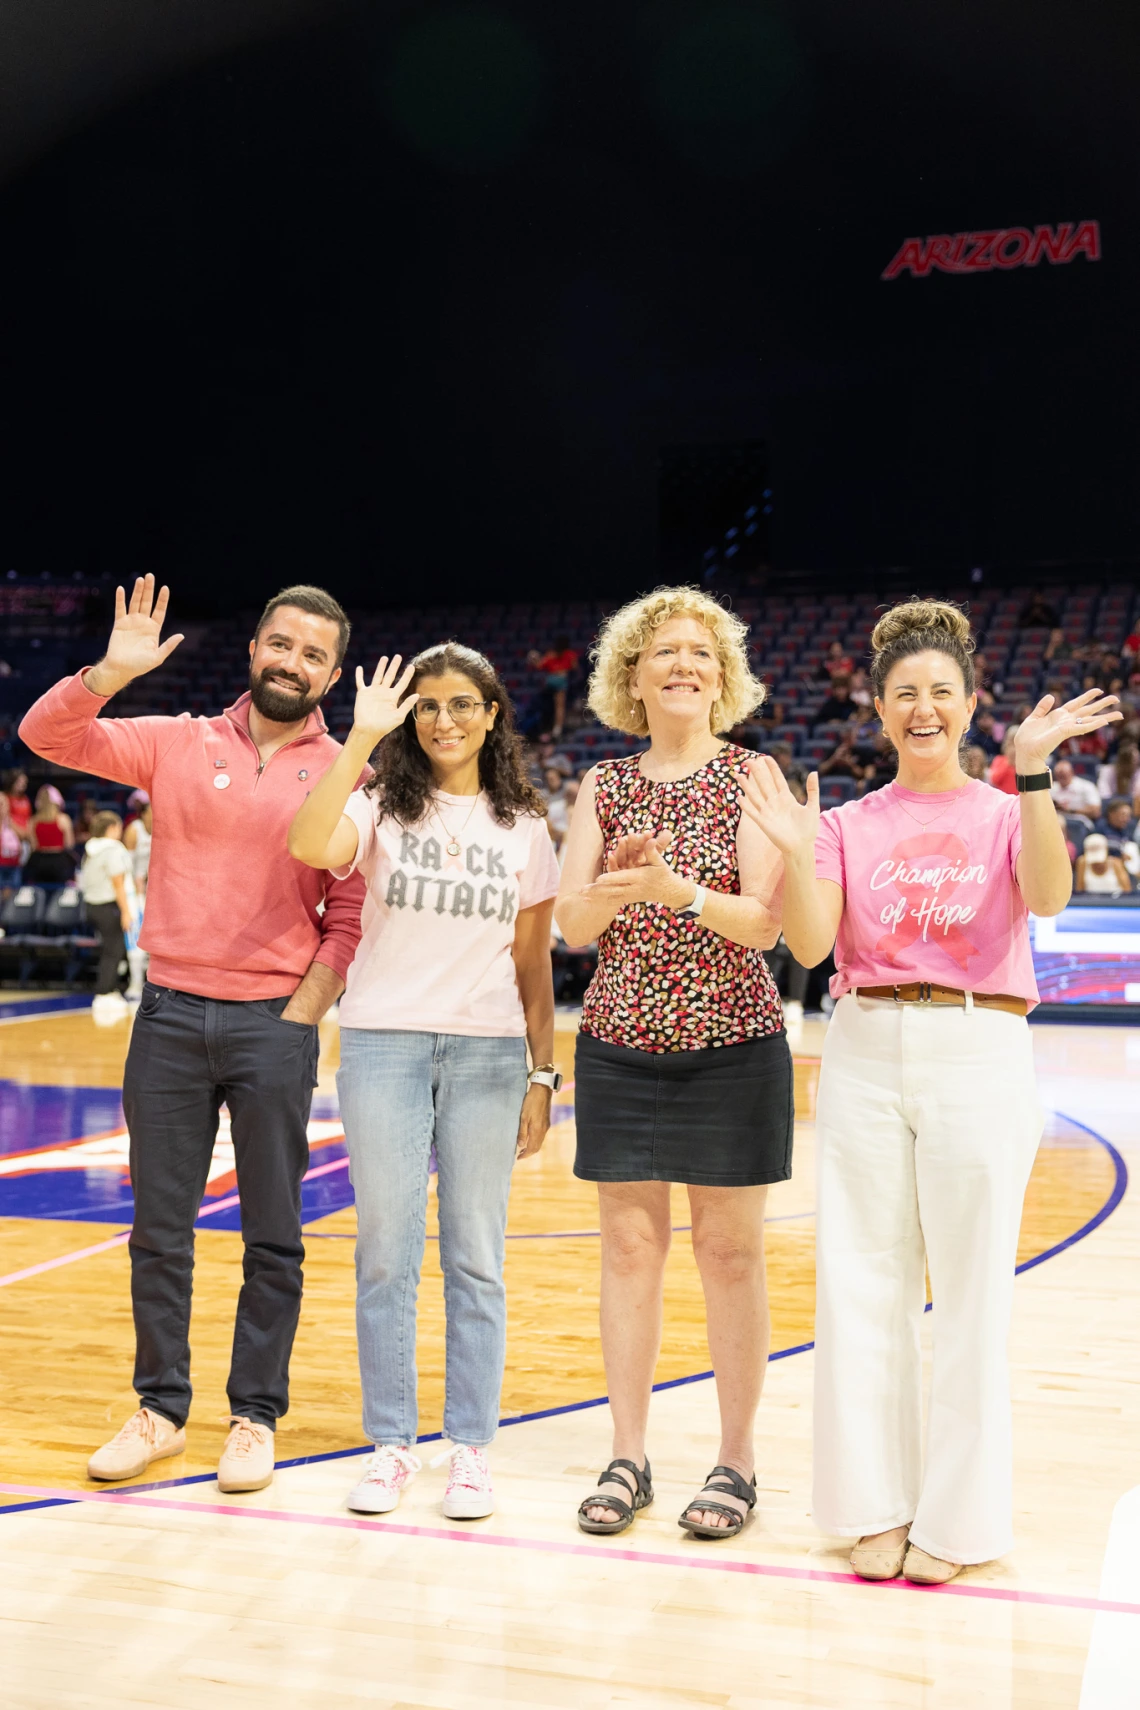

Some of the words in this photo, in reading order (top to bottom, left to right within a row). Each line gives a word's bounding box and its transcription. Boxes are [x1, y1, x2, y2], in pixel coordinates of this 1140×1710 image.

[880, 219, 1101, 281] ARIZONA
[384, 868, 516, 925] ATTACK
[869, 859, 988, 893] Champion
[879, 896, 906, 934] of
[910, 896, 977, 943] Hope
